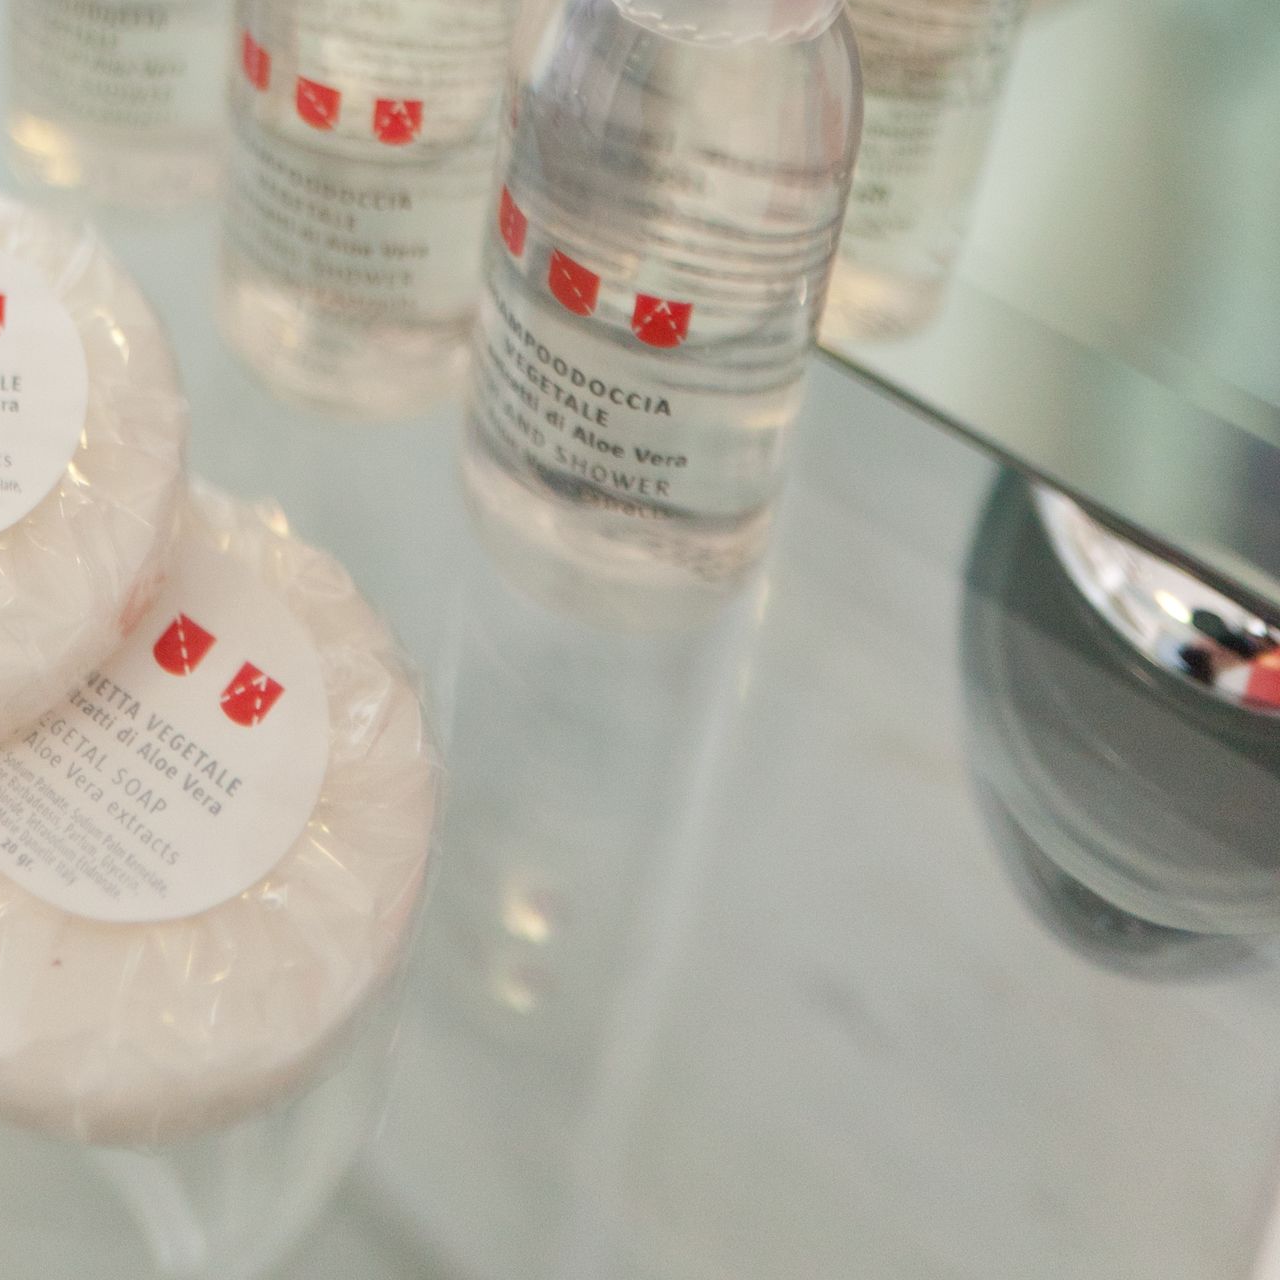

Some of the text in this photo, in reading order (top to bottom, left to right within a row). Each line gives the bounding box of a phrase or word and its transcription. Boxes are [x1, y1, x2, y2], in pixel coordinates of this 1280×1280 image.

[504, 336, 609, 428] VEGETALE
[555, 443, 671, 497] SHOWER
[572, 425, 625, 459] Aloe
[633, 446, 689, 469] Vera
[116, 725, 140, 748] di
[136, 742, 178, 780] Aloe
[181, 773, 223, 818] Vera
[146, 713, 242, 798] VEGETALE
[22, 730, 181, 867] Aloe Vera extracts
[111, 768, 168, 815] SOAP
[0, 839, 19, 854] 20
